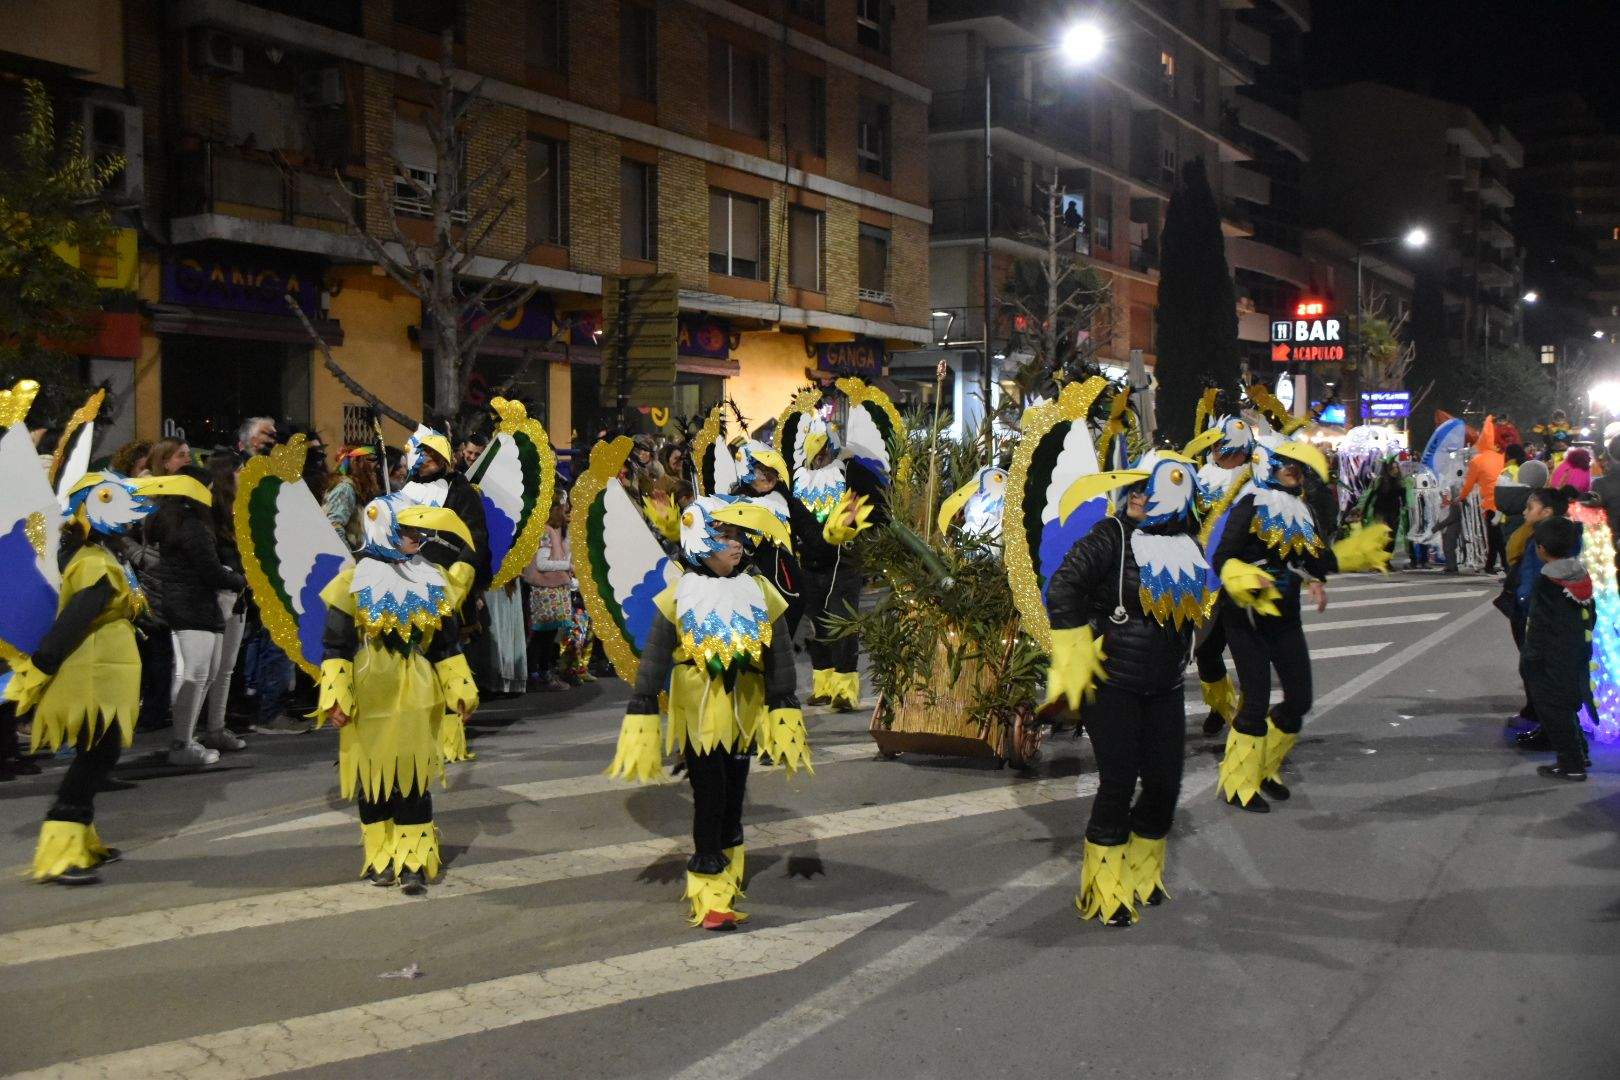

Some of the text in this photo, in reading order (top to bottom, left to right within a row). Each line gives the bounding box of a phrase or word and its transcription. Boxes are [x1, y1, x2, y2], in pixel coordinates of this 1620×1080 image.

[1295, 319, 1340, 342] BAR
[826, 343, 875, 368] GANGA
[1293, 346, 1344, 361] ACAPULCO
